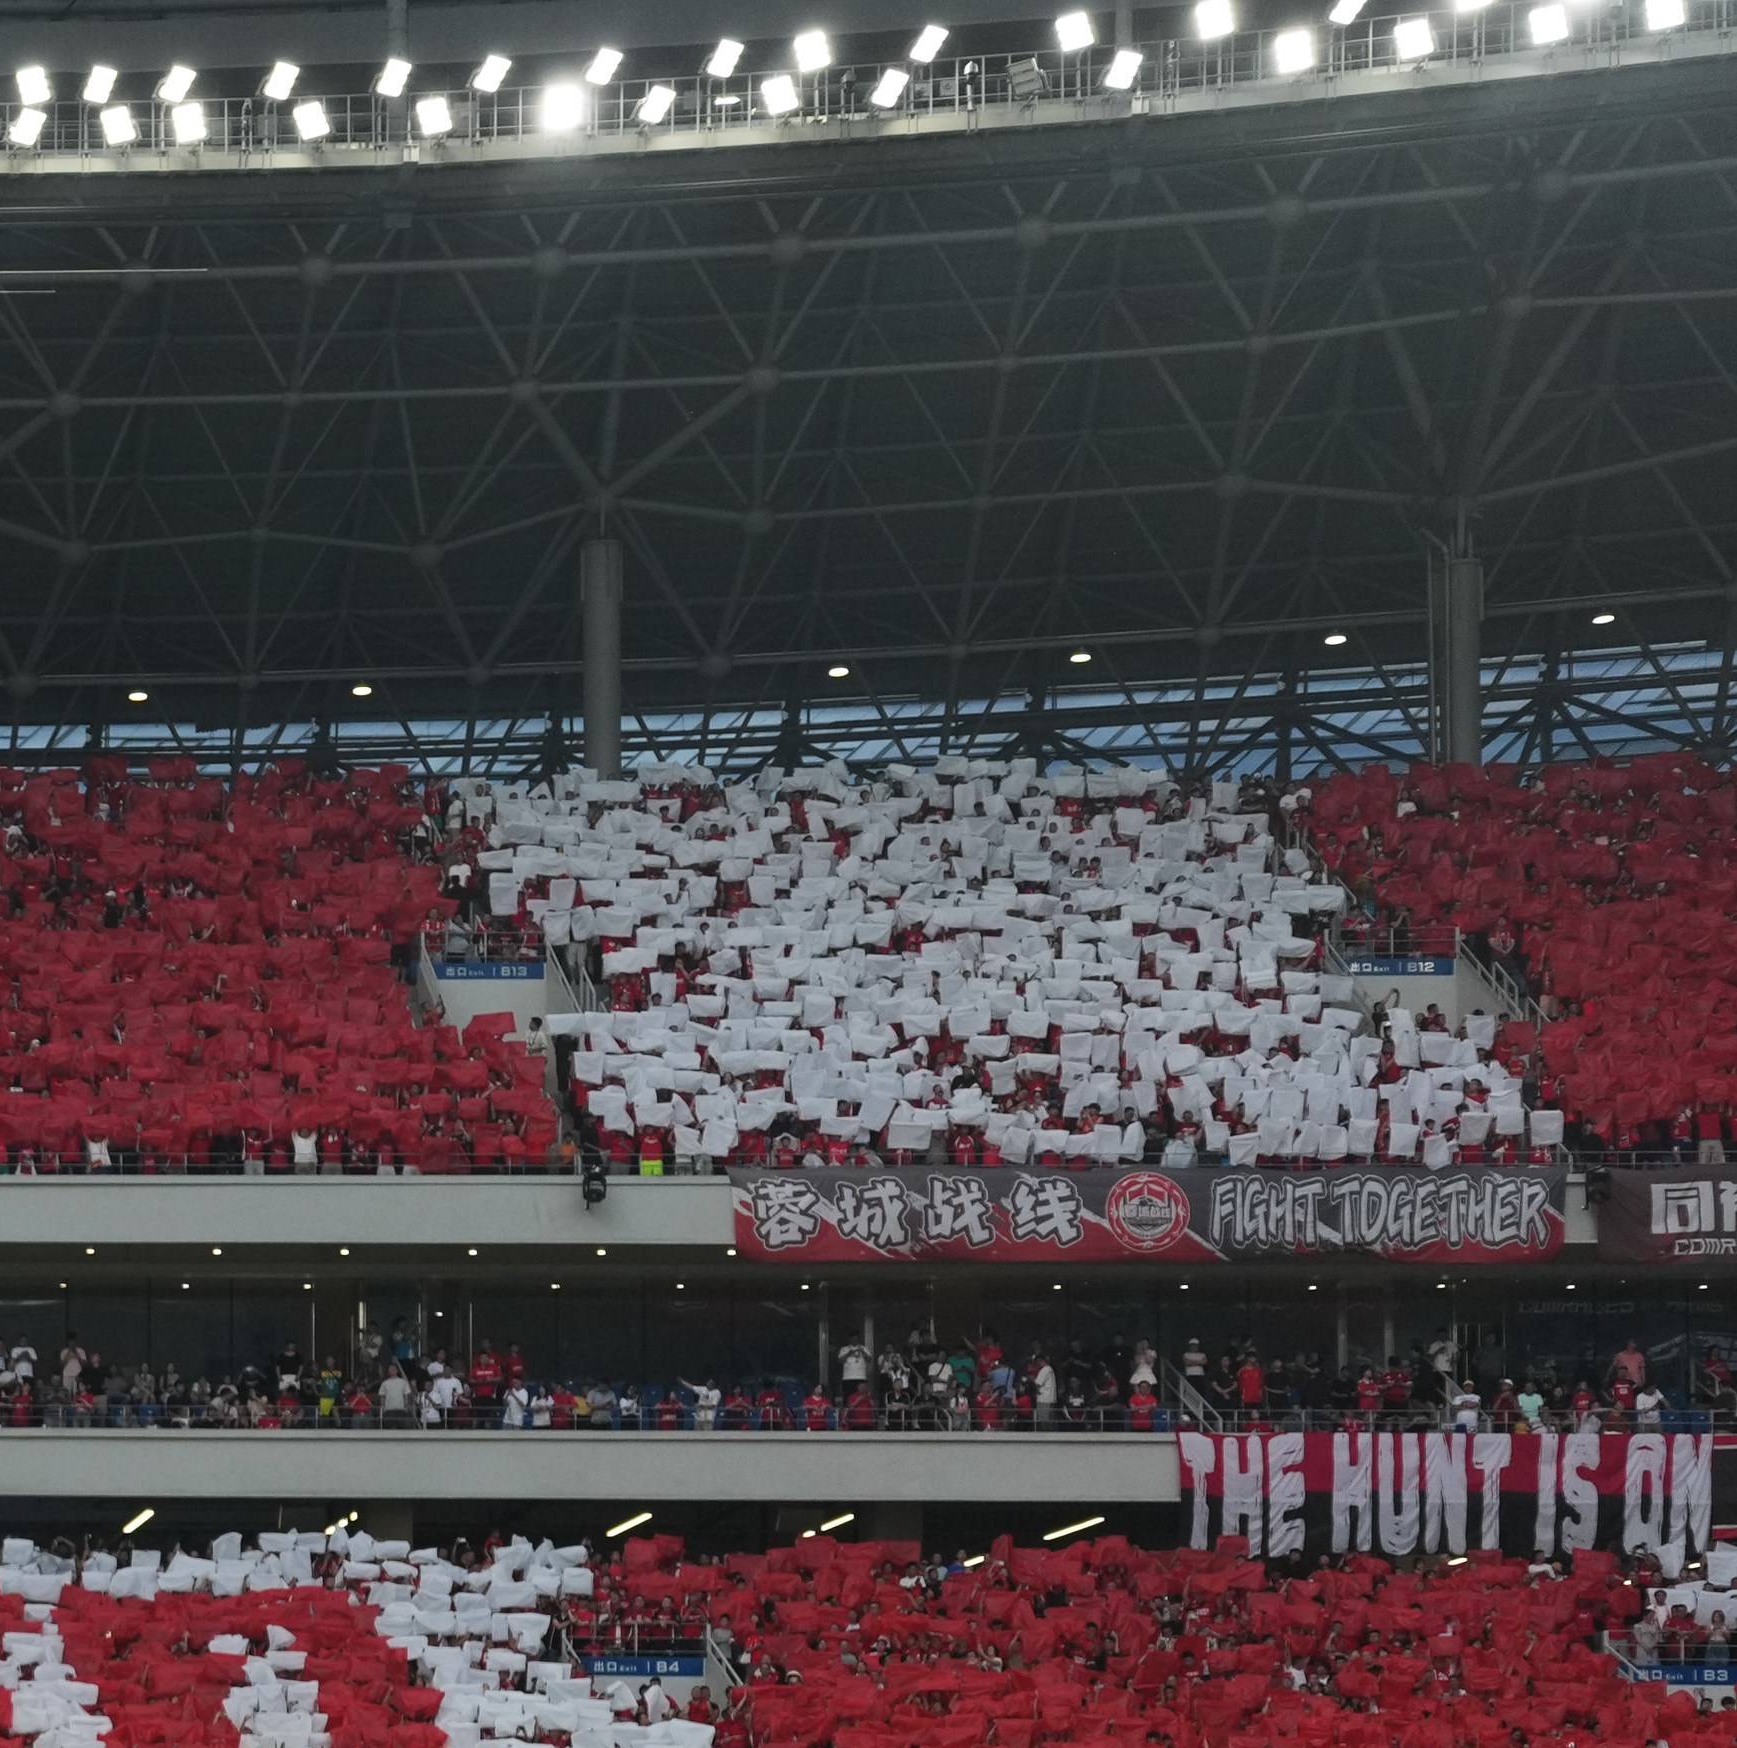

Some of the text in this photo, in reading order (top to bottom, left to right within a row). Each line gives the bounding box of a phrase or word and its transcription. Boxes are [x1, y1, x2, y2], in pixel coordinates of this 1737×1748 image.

[500, 966, 528, 977] B13
[1407, 961, 1436, 973] B12
[754, 1176, 1083, 1249] 蓉城战线
[1211, 1175, 1551, 1249] FIGHT TOGETHER
[1178, 1431, 1712, 1558] THE HUNT IS ON
[656, 1660, 681, 1673] B4
[1703, 1669, 1729, 1681] B3
